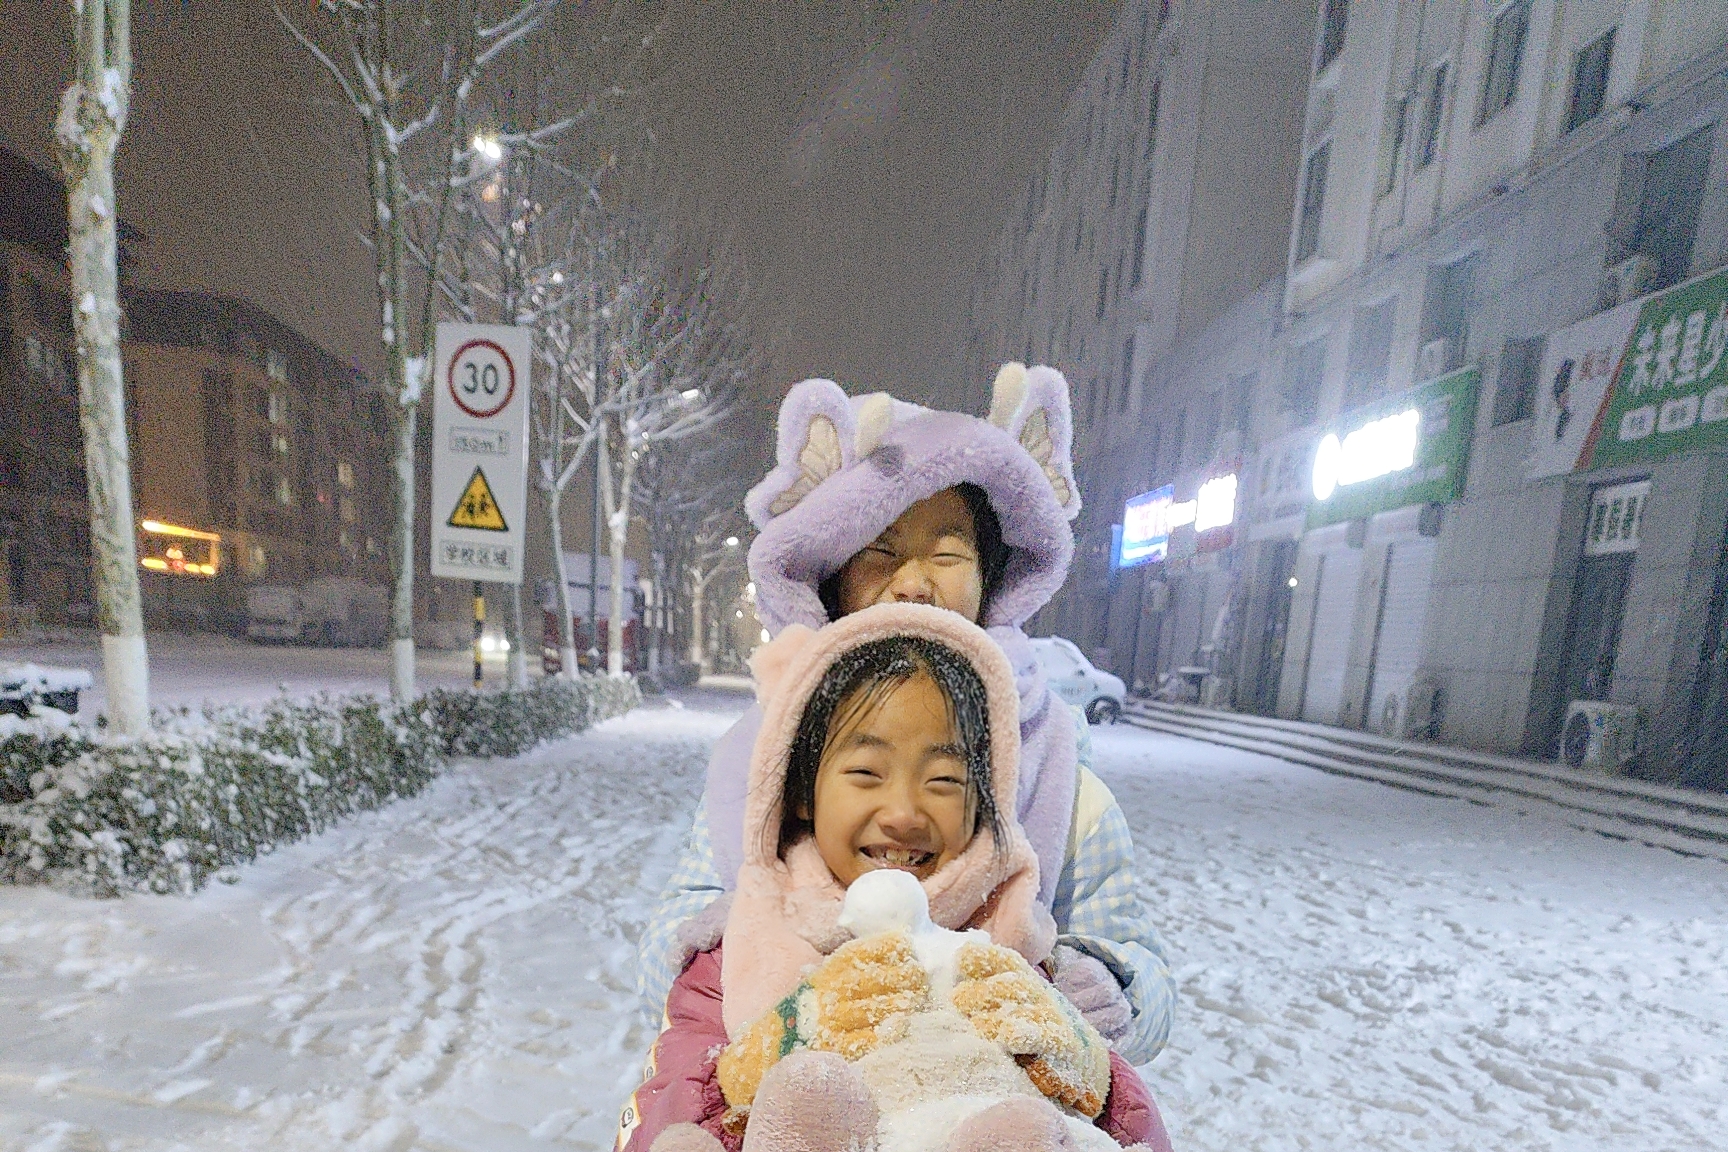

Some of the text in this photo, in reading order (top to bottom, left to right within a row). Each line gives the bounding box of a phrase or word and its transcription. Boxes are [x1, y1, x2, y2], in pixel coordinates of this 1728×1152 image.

[463, 362, 499, 395] 30
[445, 543, 508, 567] 学校区域
